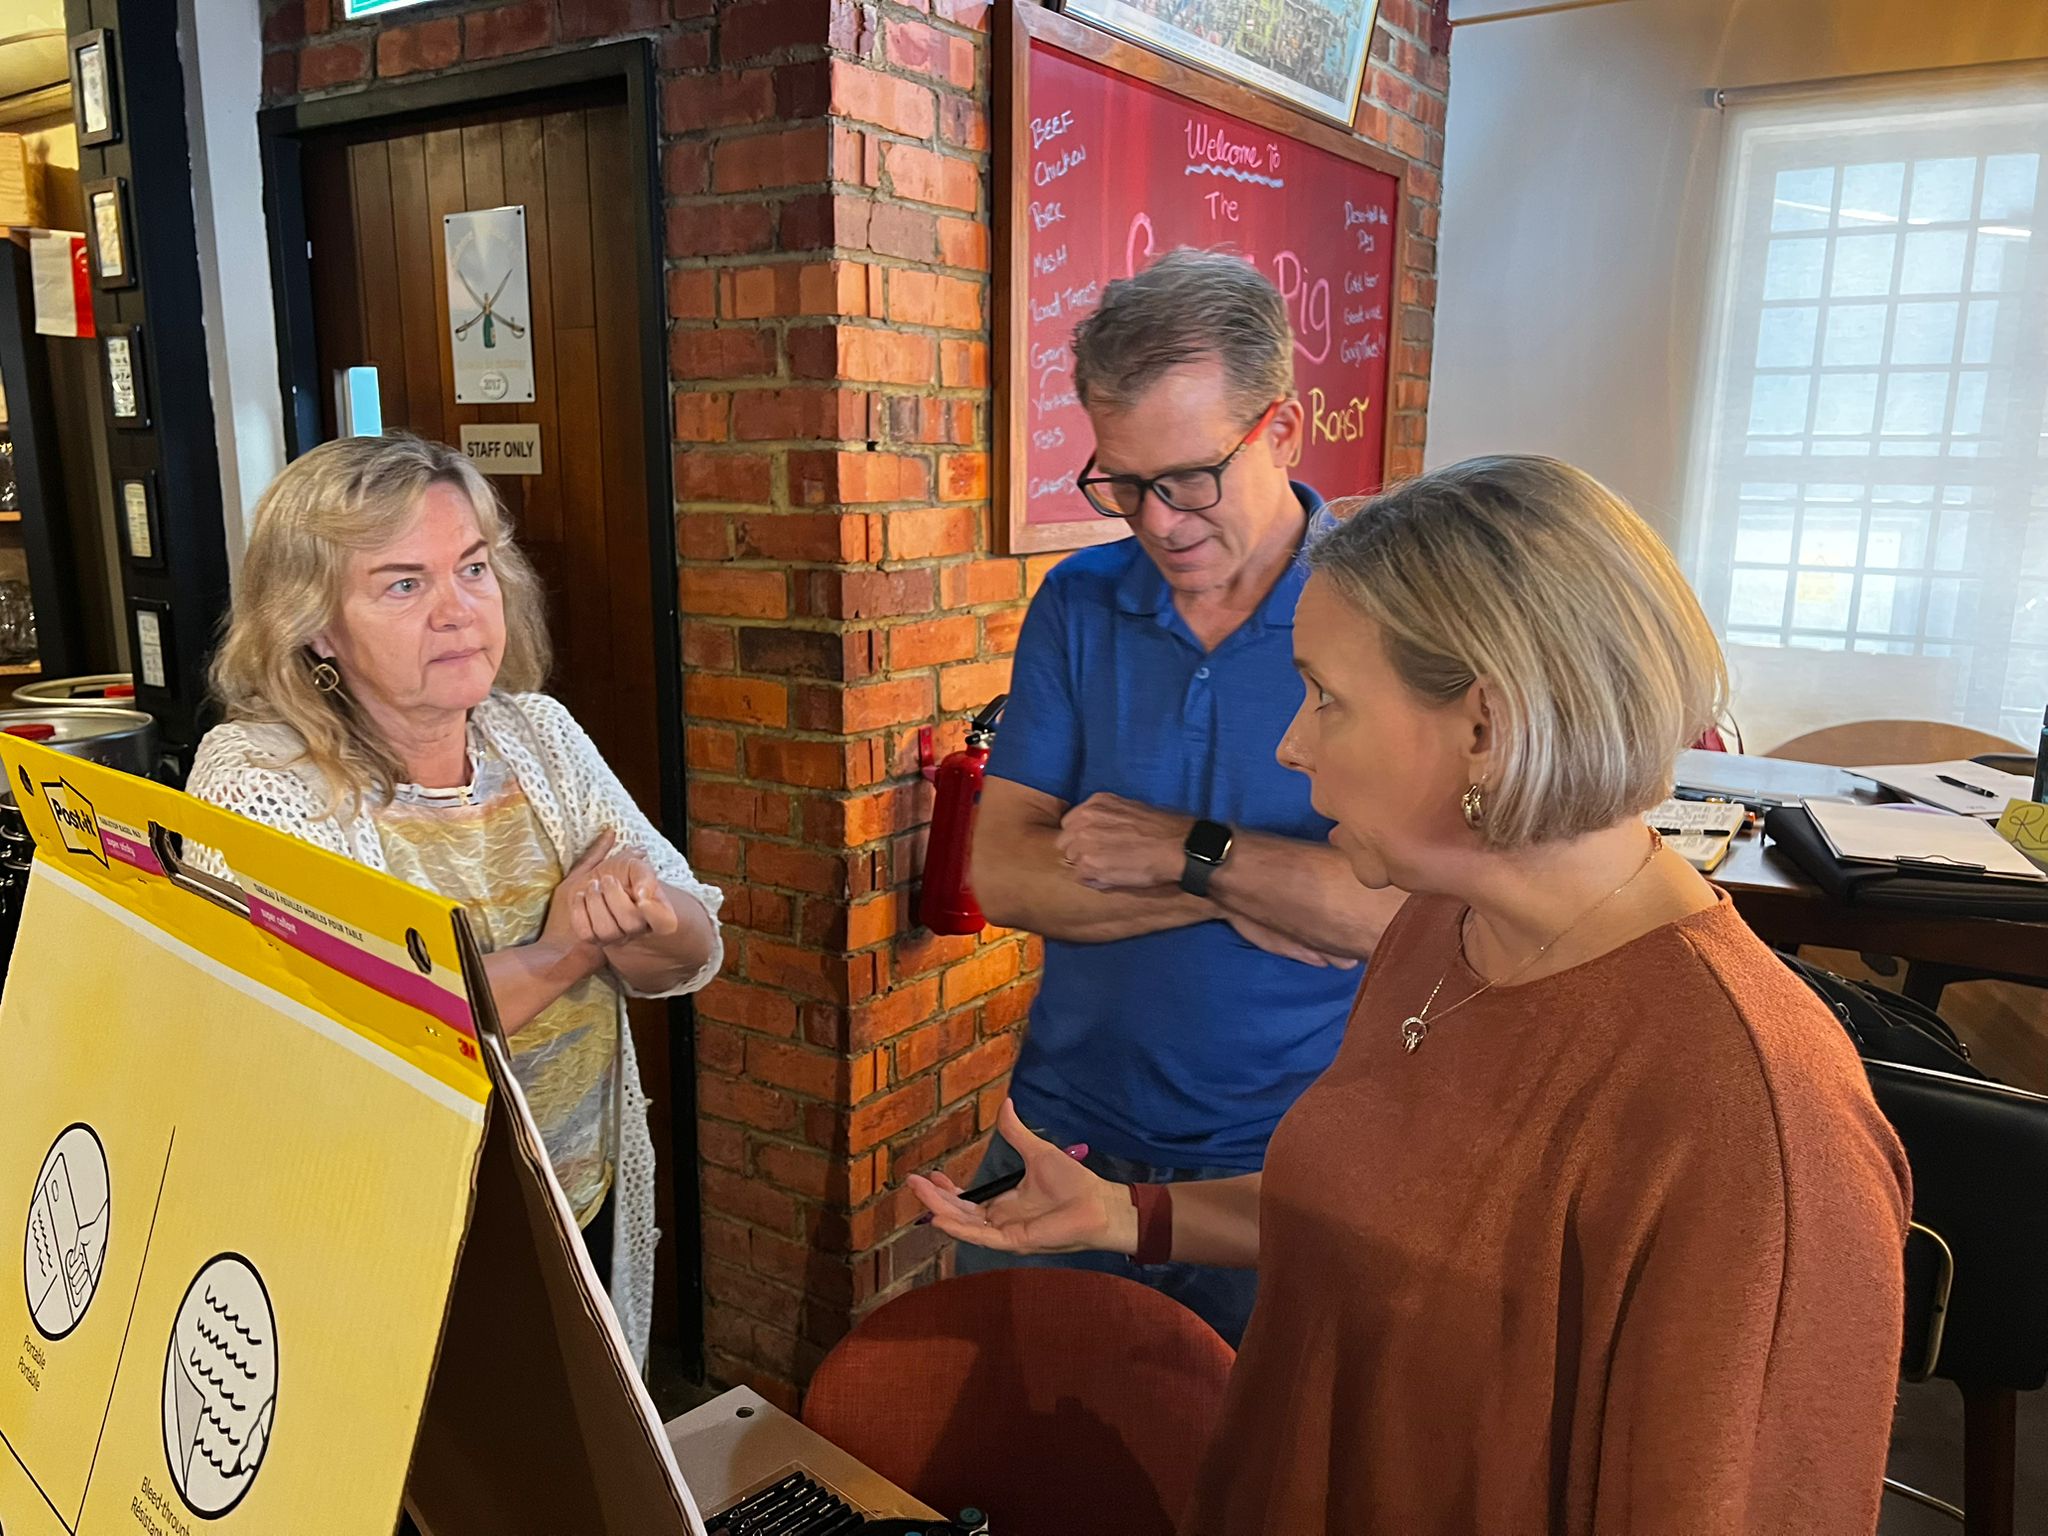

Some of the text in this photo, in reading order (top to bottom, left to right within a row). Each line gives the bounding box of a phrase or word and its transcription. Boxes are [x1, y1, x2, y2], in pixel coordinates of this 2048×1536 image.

[1029, 109, 1074, 150] BEEF
[1184, 119, 1262, 168] Welcome
[1204, 191, 1239, 222] The
[467, 441, 534, 458] STAFF ONLY
[51, 797, 97, 837] Post-it
[343, 926, 364, 942] TABLE
[457, 1038, 477, 1061] 3M
[23, 1334, 46, 1370] Portable
[17, 1355, 40, 1392] Portable
